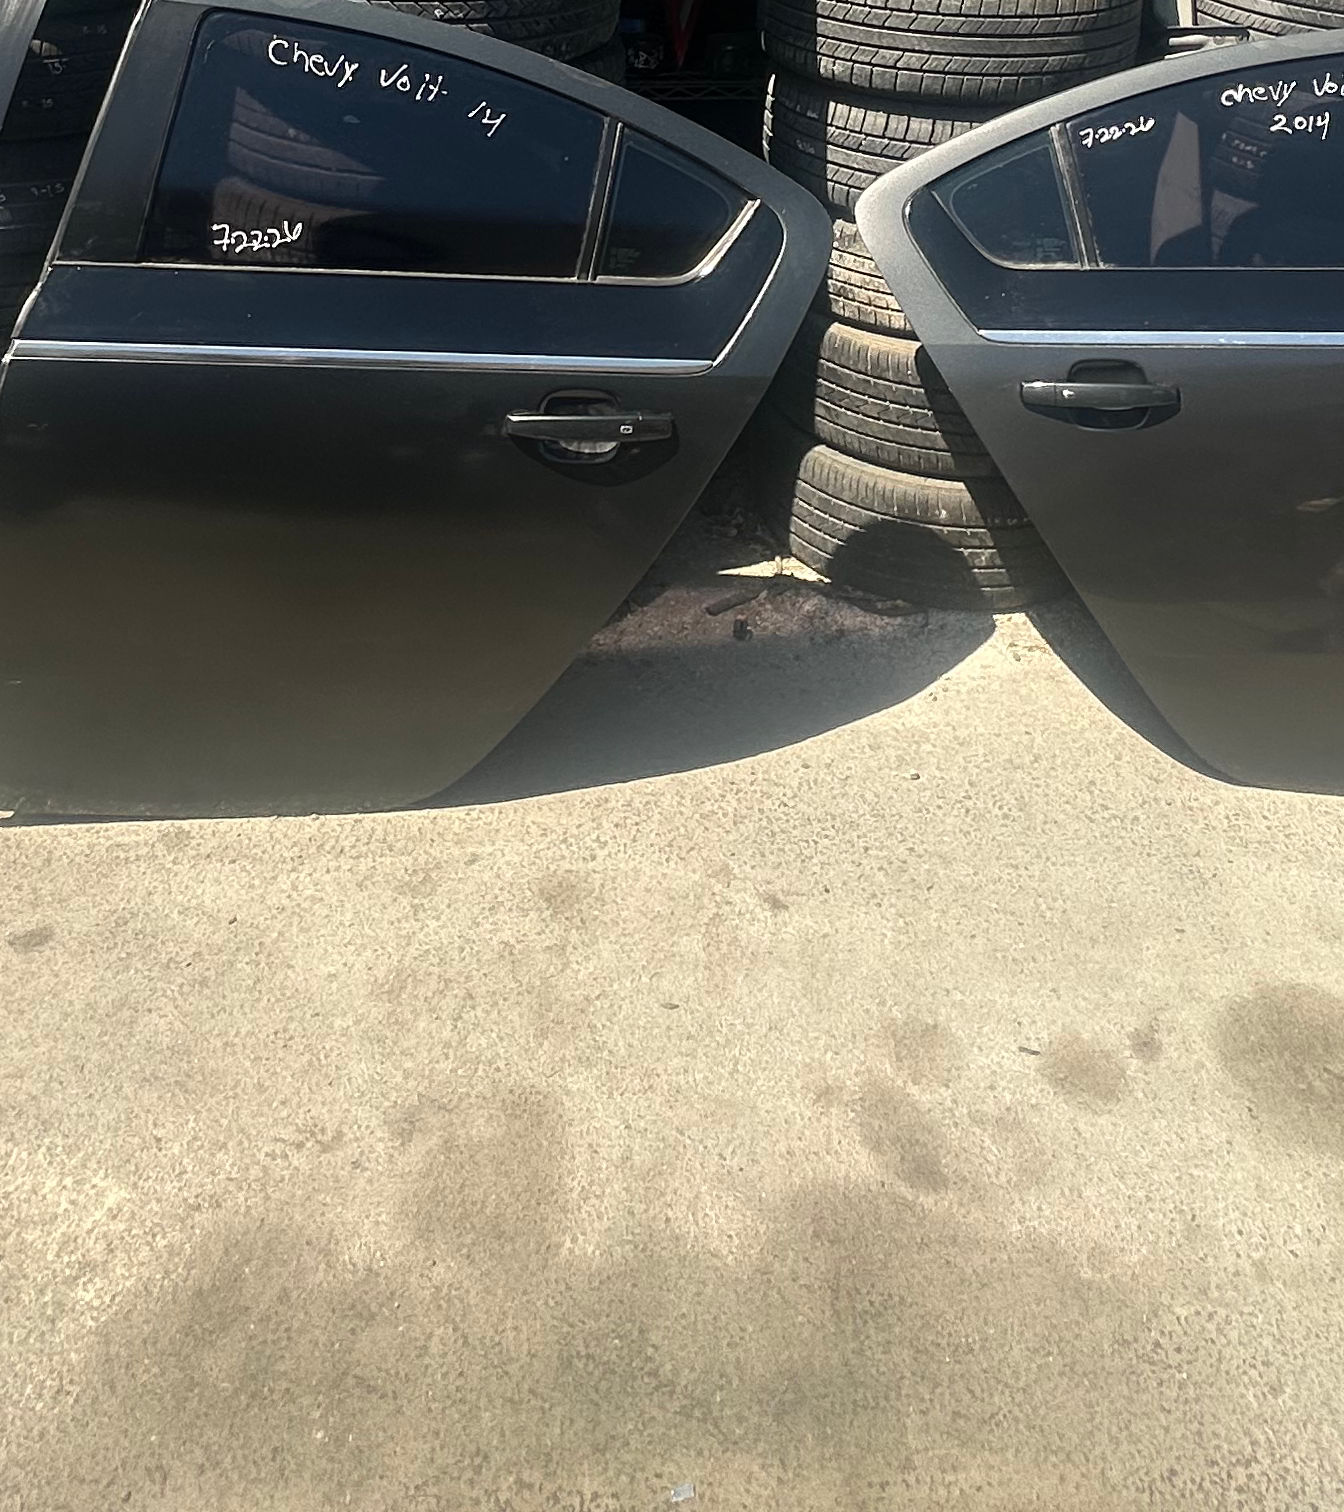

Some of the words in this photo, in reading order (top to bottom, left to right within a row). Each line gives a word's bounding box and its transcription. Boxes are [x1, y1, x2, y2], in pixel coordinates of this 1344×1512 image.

[268, 35, 359, 88] Chevy
[467, 100, 506, 137] 14
[1269, 110, 1331, 141] 2014
